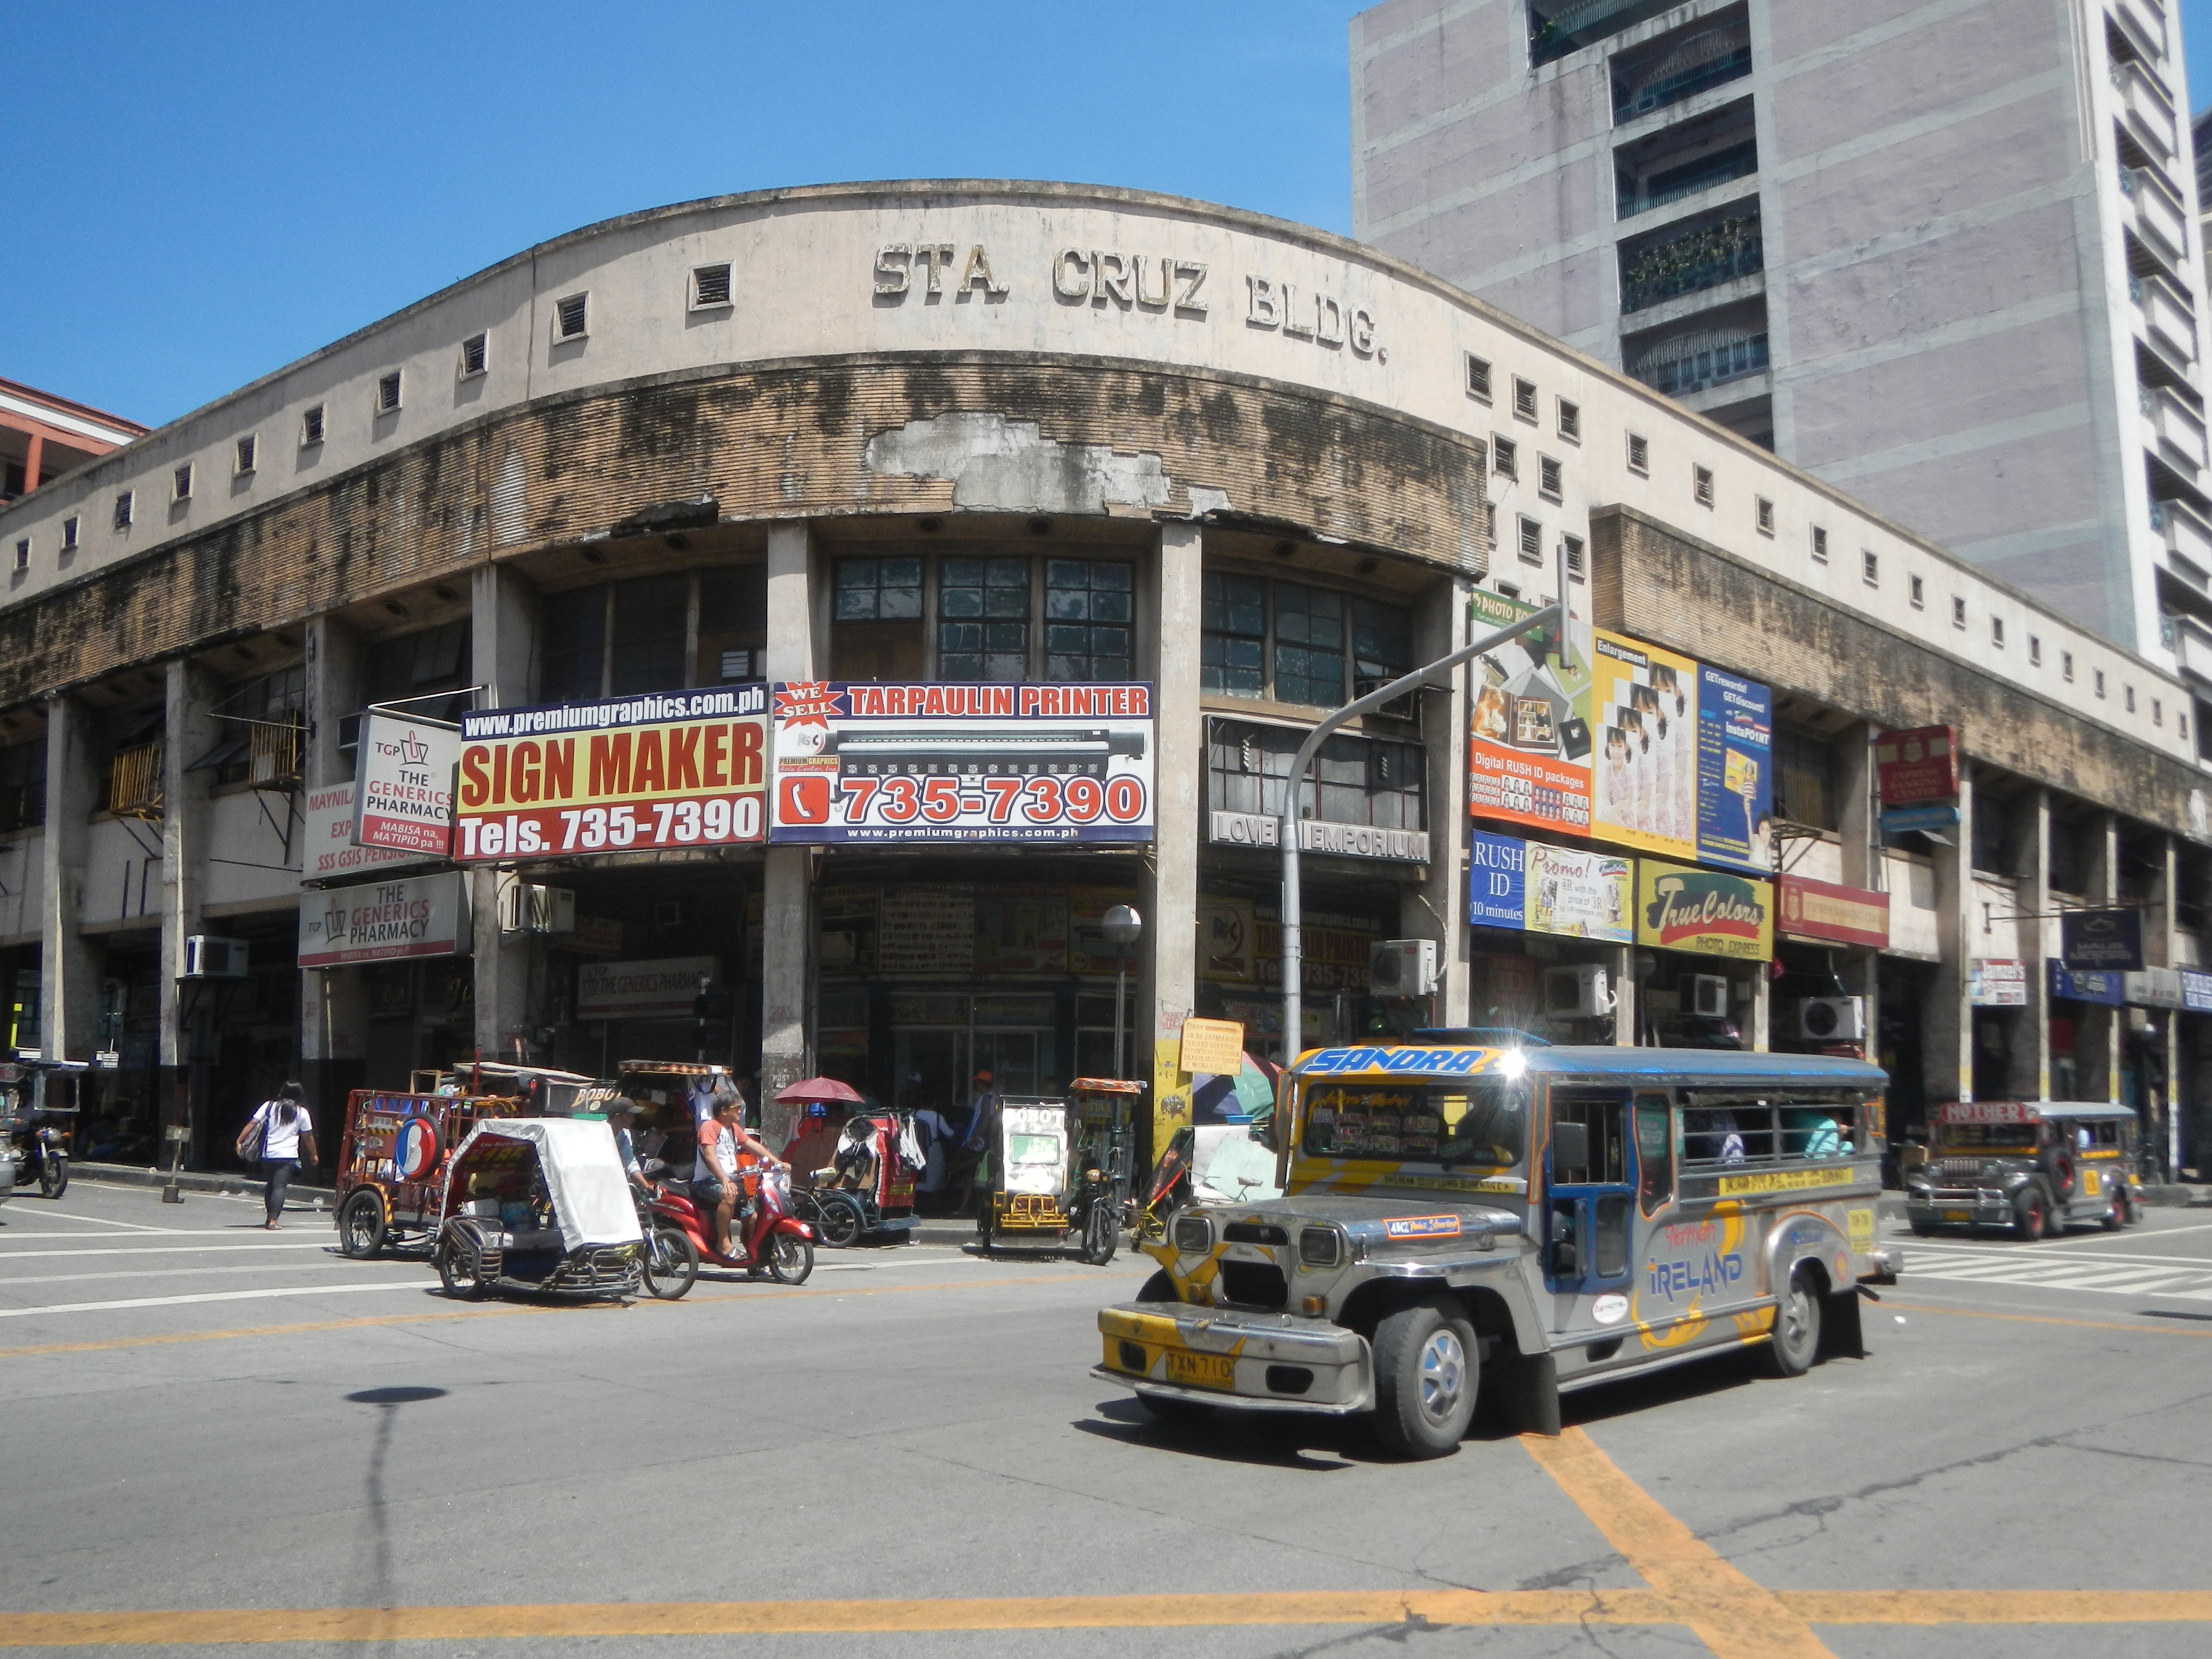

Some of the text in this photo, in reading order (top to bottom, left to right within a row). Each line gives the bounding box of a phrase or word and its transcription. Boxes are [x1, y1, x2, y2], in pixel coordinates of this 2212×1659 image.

[872, 243, 1388, 363] STA. CRUZ BLDG.
[1482, 596, 1513, 619] PHOTO
[1597, 639, 1647, 666] Enlargement
[790, 687, 822, 700] WE
[847, 686, 1149, 716] TARPAULIN PRINTER
[465, 686, 764, 736] www.premiumgraphics.com.ph
[783, 703, 831, 718] SELL
[375, 742, 400, 757] TGP
[461, 722, 764, 807] SIGN MAKER
[1475, 752, 1584, 789] Digital RUSH ID packages
[398, 769, 429, 787] THE
[309, 789, 355, 812] MAYNIL
[369, 780, 453, 806] GENERICS
[840, 774, 1146, 824] 735-7390
[331, 820, 351, 838] EXP
[381, 822, 438, 839] MABISA na,
[459, 797, 760, 855] Tels. 735-7390
[847, 828, 1078, 839] www.premiumgraphics.com.ph
[1217, 815, 1425, 860] LOVE EMPORIUM
[373, 831, 419, 846] MATIPID
[421, 838, 433, 848] pa
[318, 854, 335, 871] SSS
[338, 848, 361, 868] GSIS
[1475, 841, 1524, 873] RUSH
[1529, 846, 1591, 878] Promo!
[377, 884, 405, 903] THE
[1490, 873, 1510, 897] ID
[1575, 885, 1586, 893] with
[1588, 887, 1597, 895] the
[351, 899, 429, 926] GENERICS
[1473, 901, 1524, 921] 10 minutes
[1568, 896, 1582, 905] price
[1592, 897, 1602, 909] 3R
[350, 919, 429, 944] PHARMACY
[1695, 936, 1760, 955] PHOTO EXPRESS
[601, 976, 616, 994] THE
[618, 974, 658, 993] GENERICS
[1301, 1047, 1484, 1073] SANDRA
